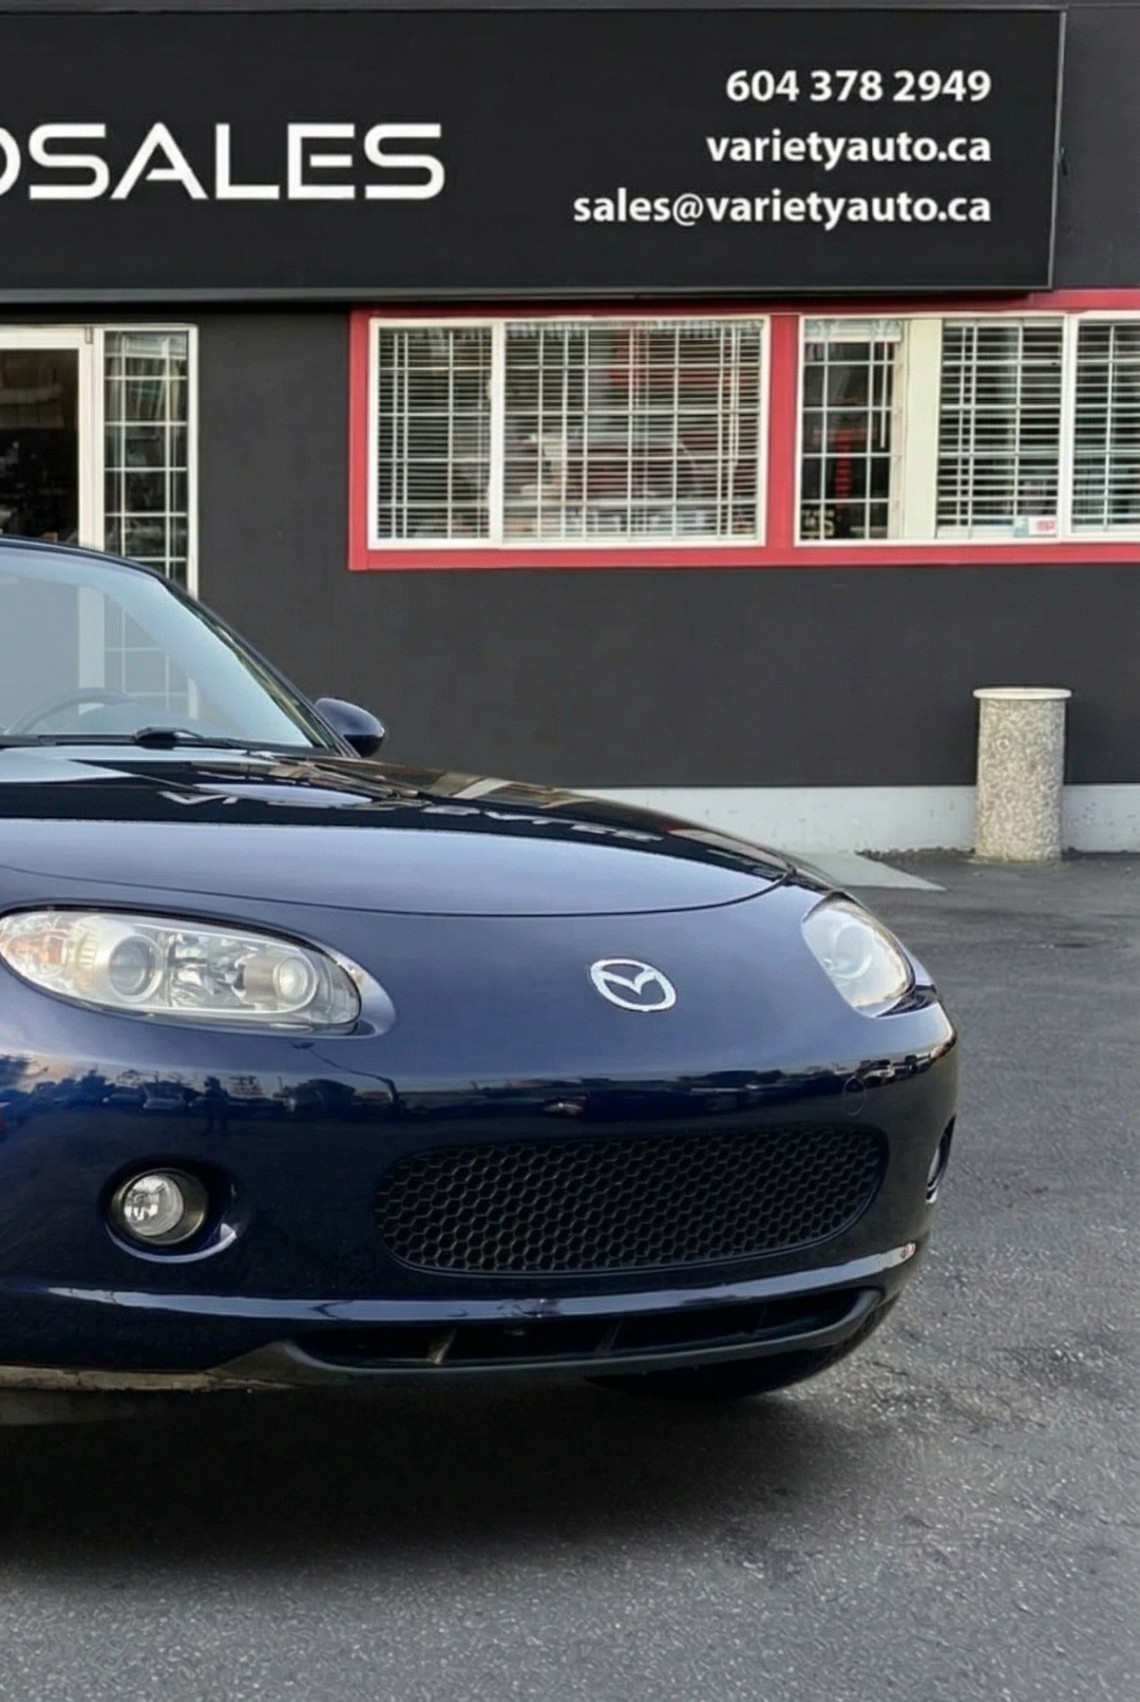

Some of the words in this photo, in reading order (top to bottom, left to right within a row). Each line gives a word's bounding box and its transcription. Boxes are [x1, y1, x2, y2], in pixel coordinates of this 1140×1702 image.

[726, 69, 800, 102] 604
[809, 69, 884, 102] 378
[892, 69, 992, 102] 2949
[706, 127, 992, 171] varietyauto.ca
[573, 187, 992, 231] sales@varietyauto.ca
